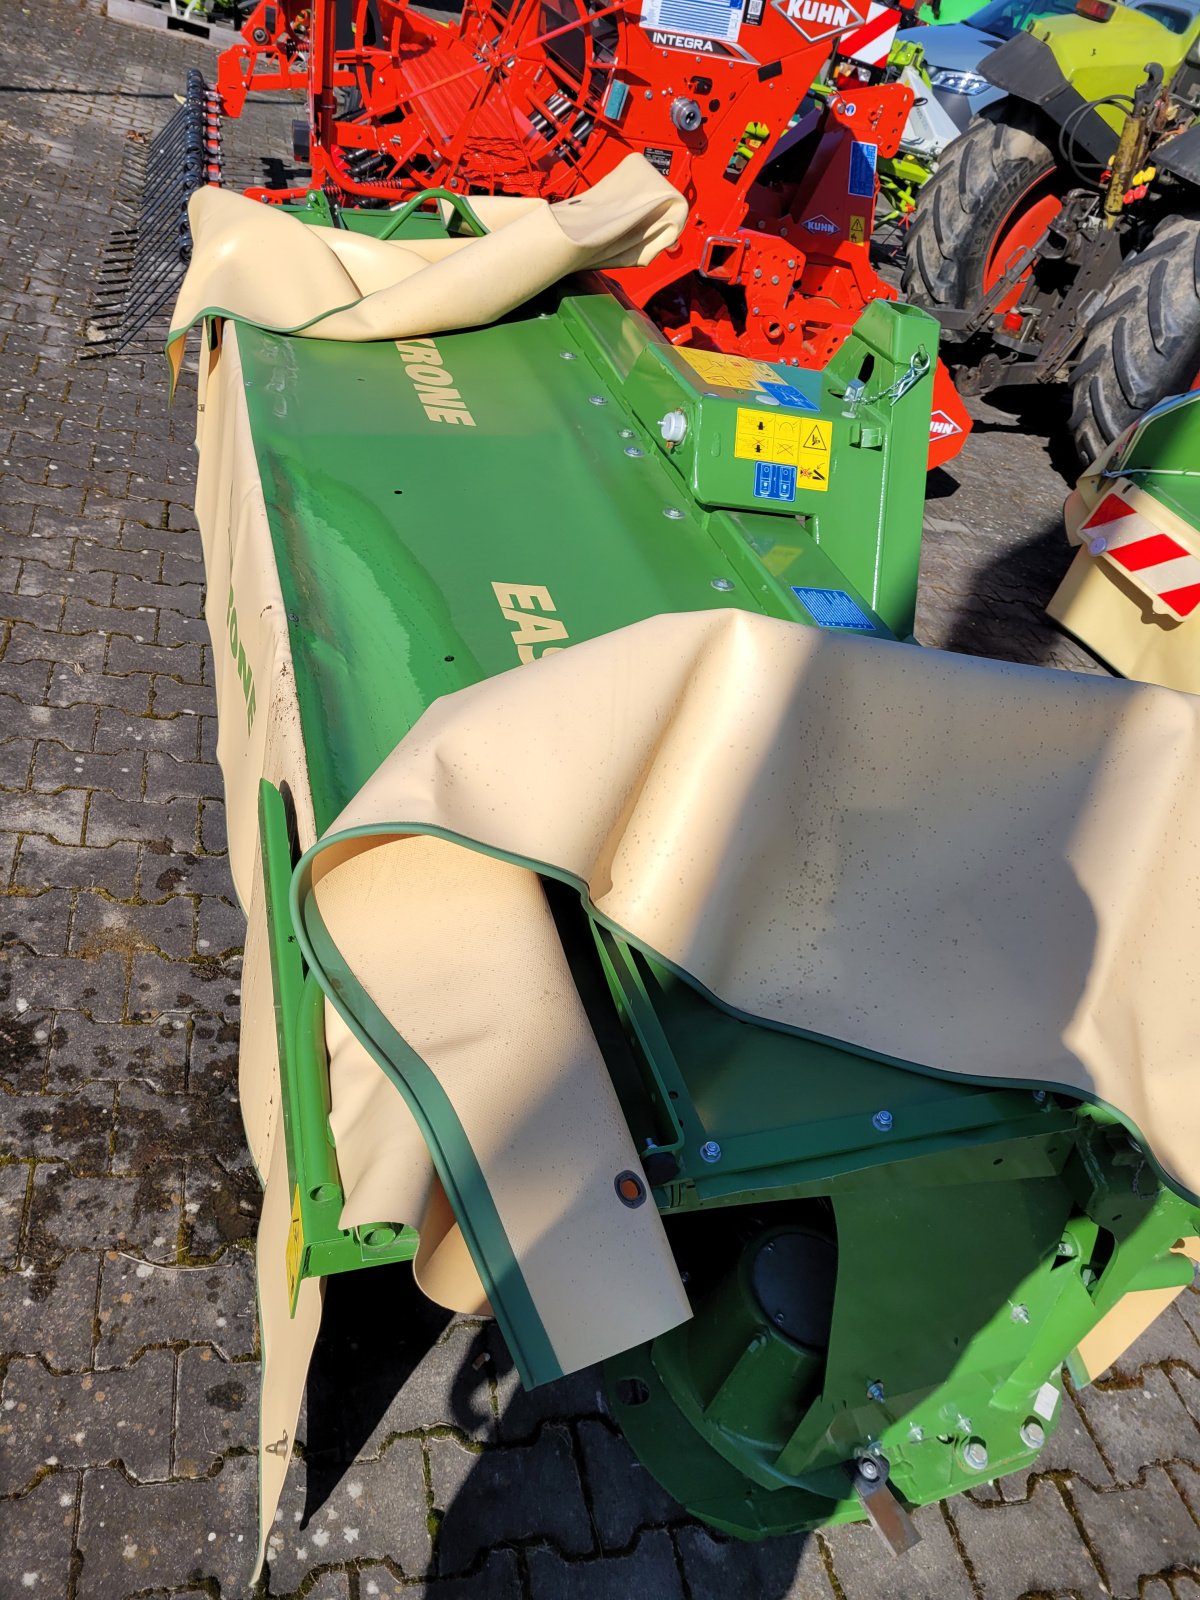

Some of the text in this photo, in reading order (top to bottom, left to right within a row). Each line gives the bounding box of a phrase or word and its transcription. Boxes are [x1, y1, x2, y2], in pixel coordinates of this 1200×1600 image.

[787, 0, 850, 28] KUHN
[652, 32, 714, 52] INTEGRA
[807, 221, 835, 233] KUHN
